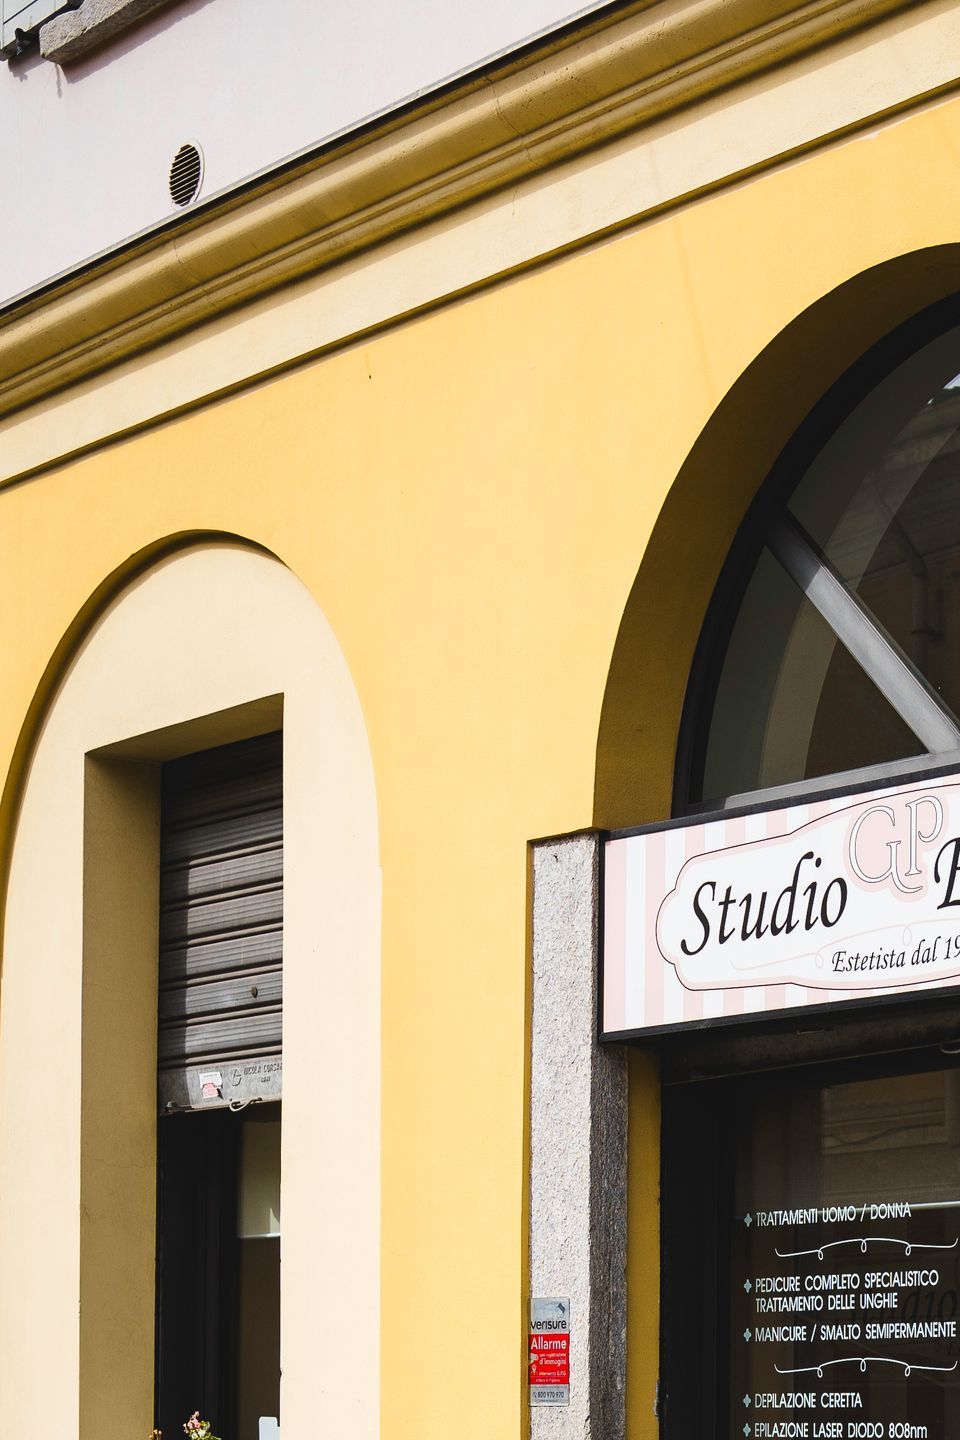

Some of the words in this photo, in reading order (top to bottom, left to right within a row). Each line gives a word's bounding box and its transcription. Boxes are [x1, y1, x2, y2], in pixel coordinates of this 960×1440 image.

[680, 851, 848, 956] Studio
[849, 795, 943, 894] GP
[832, 947, 906, 972] Estetista
[911, 936, 941, 965] dal
[756, 1209, 817, 1226] TRATTAMENTI
[822, 1205, 856, 1223] UOMO
[871, 1202, 911, 1219] DONNA
[756, 1276, 800, 1292] PEDICURE
[805, 1274, 860, 1291] COMPLETO
[865, 1270, 938, 1289] SPECIALISTICO
[756, 1296, 823, 1313] TRATTAMENTO
[828, 1295, 855, 1310] DELLE
[860, 1293, 898, 1309] UNGHIE
[531, 1320, 566, 1330] verisure
[755, 1325, 807, 1342] MANICURE
[820, 1324, 861, 1341] SMALTO
[865, 1321, 956, 1339] SEMIPERMANENTE
[531, 1337, 566, 1350] Allarme
[755, 1393, 816, 1408] DEPILAZIONE
[821, 1393, 862, 1408] CERETTA
[755, 1423, 808, 1438] EPILAZIONE
[813, 1423, 843, 1438] LASER
[848, 1423, 883, 1438] DIODO
[888, 1423, 927, 1439] 808nm
